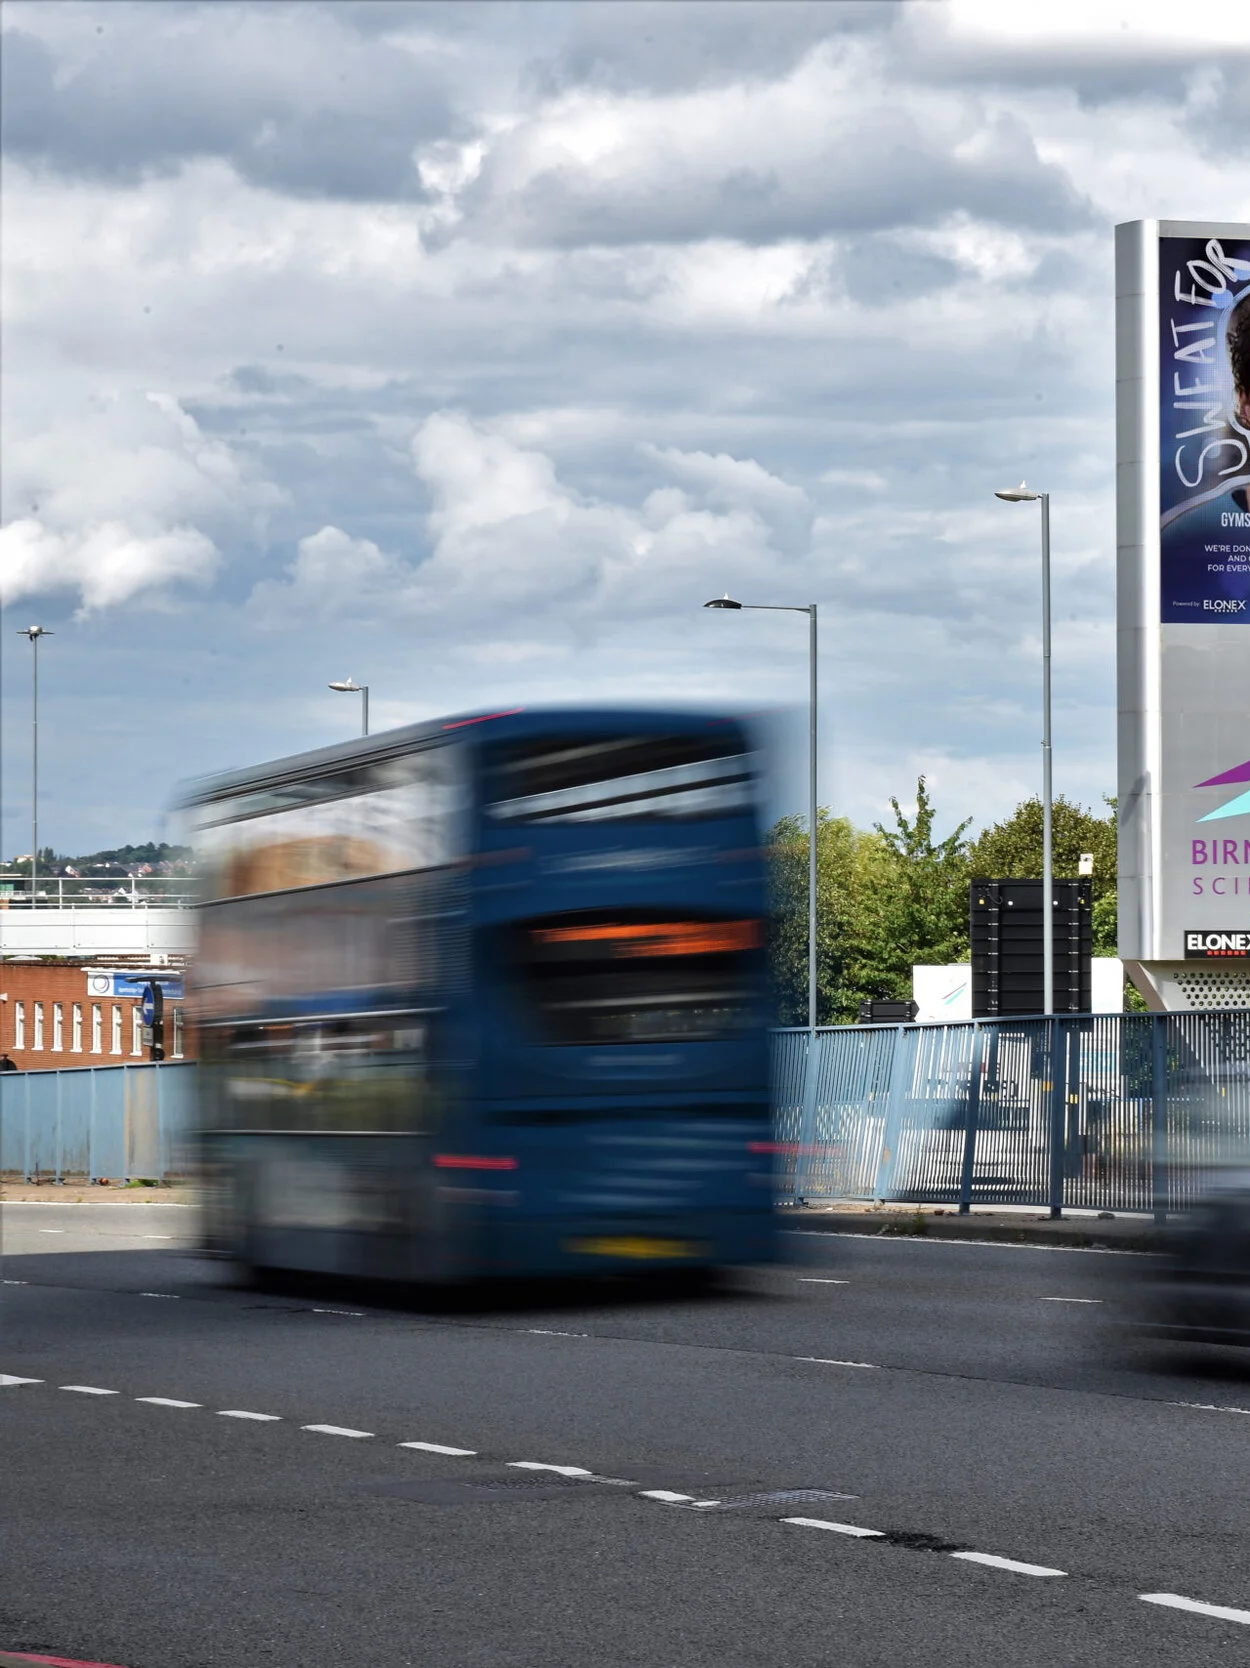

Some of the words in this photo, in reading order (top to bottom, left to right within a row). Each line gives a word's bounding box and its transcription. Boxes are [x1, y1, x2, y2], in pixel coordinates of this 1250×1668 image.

[1171, 318, 1247, 487] SWEAT
[1204, 545, 1231, 553] WE'RE
[1207, 564, 1225, 572] FOR
[1203, 599, 1246, 610] ELONEX
